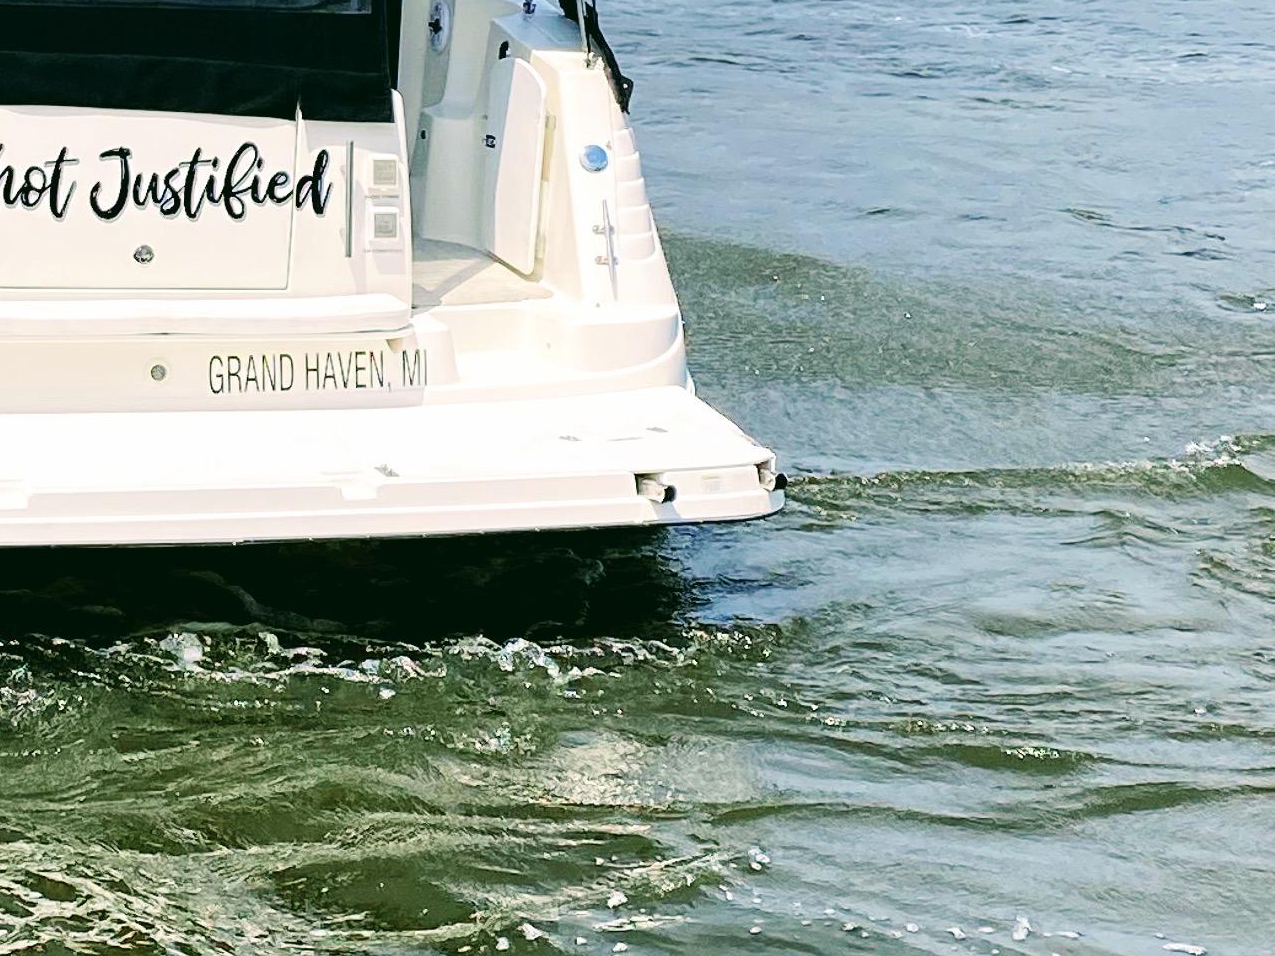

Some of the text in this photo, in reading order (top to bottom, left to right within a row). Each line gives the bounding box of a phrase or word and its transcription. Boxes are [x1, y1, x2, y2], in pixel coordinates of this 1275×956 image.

[89, 141, 333, 221] Justified
[208, 348, 428, 394] GRAND HAVEN, MI
